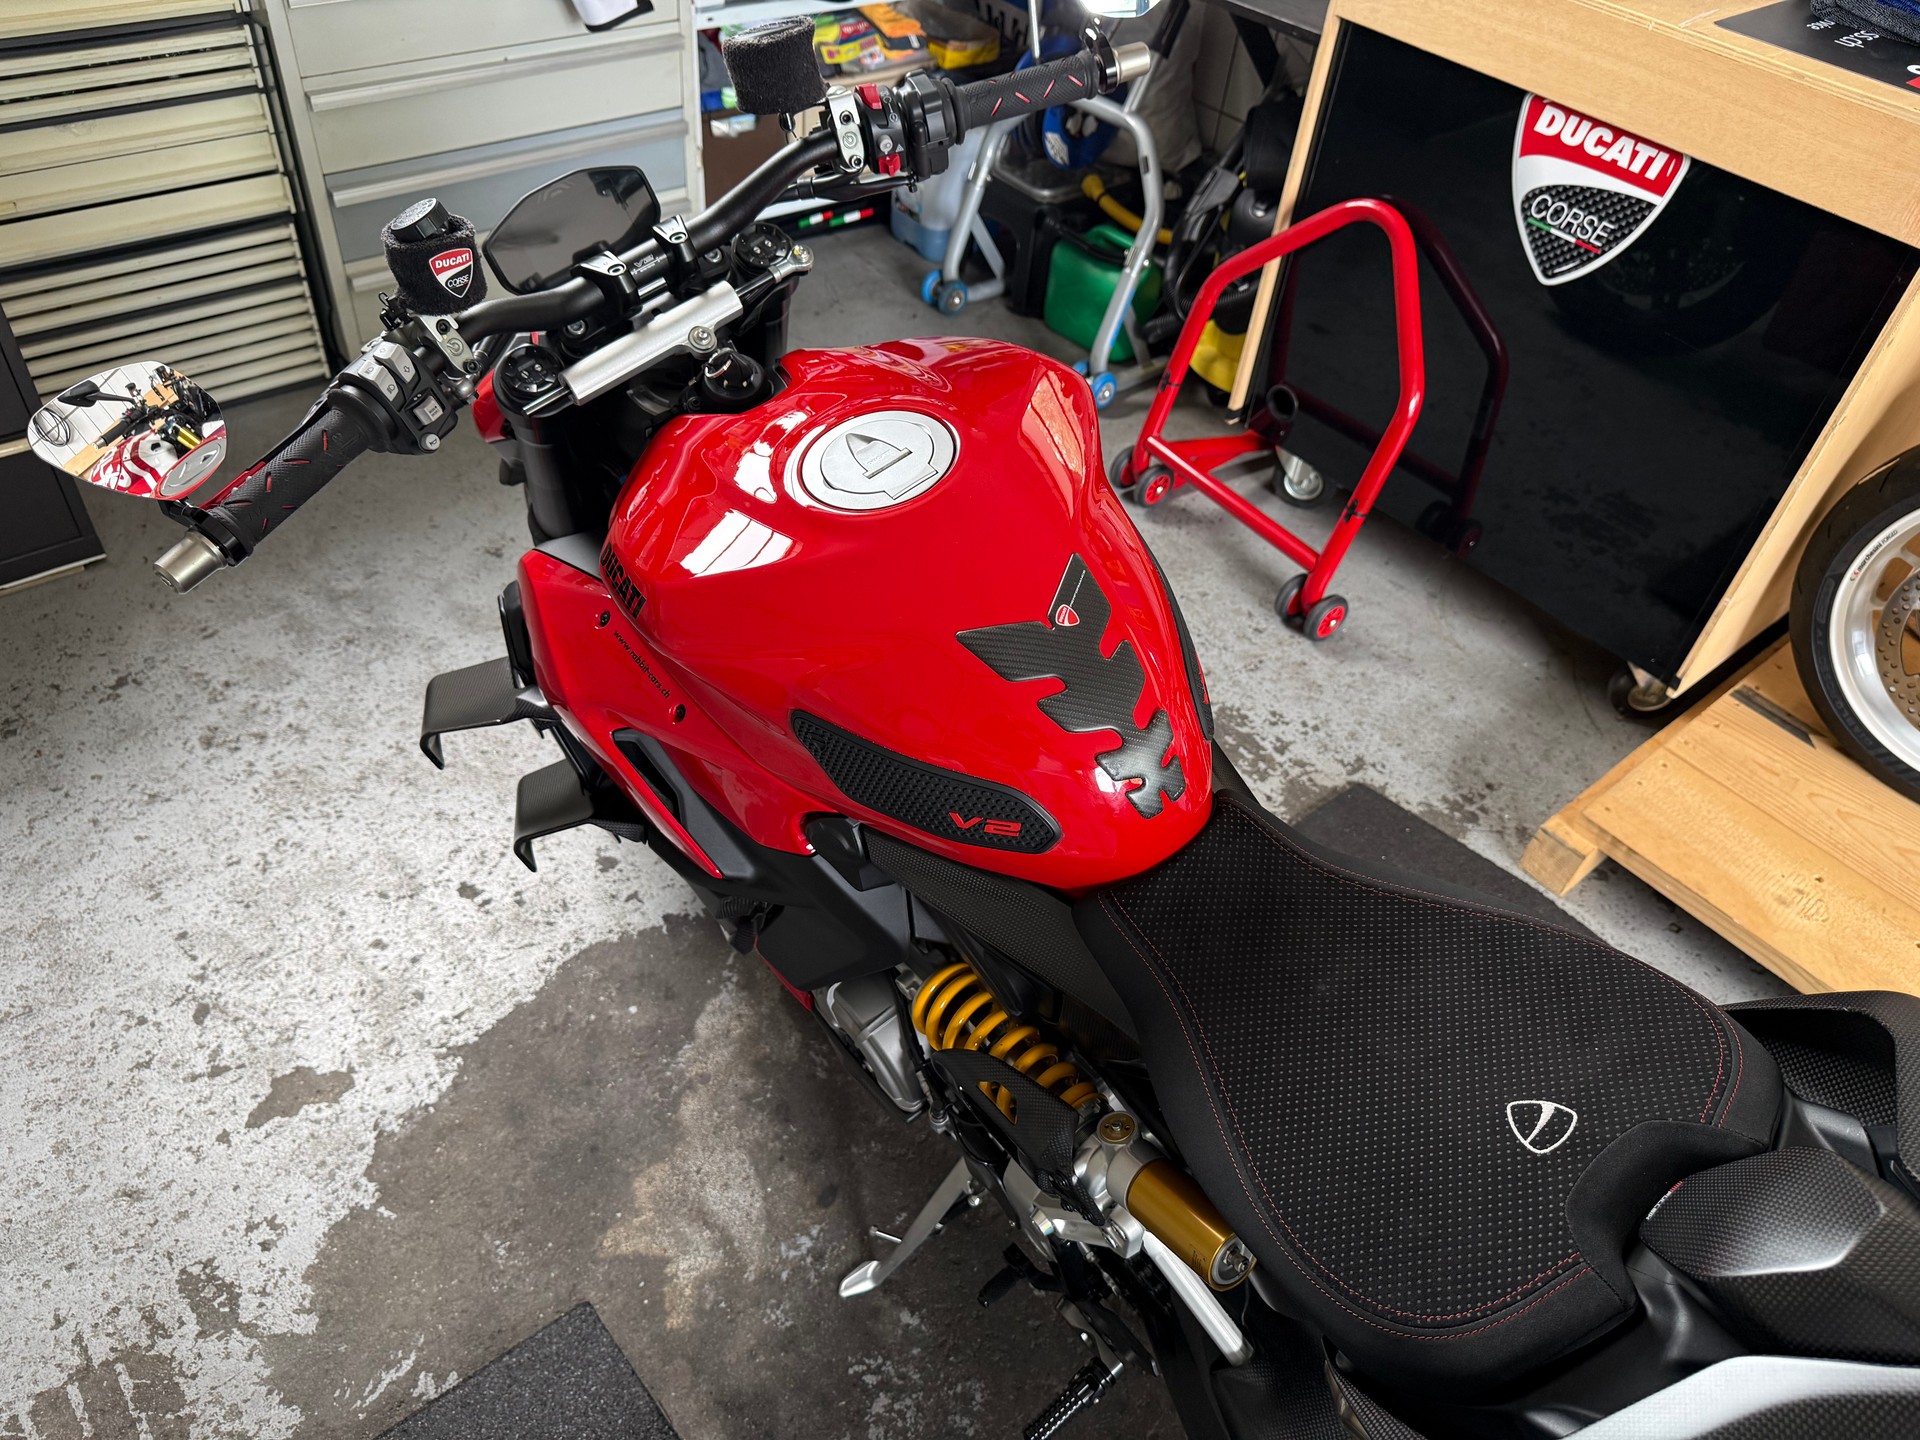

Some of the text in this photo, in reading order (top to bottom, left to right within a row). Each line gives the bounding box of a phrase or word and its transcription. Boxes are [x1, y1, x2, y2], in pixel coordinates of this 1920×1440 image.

[1834, 30, 1880, 48] ss.ch
[1533, 104, 1670, 181] DUCATI
[1530, 194, 1615, 246] CORSE
[435, 252, 470, 269] DUCATI
[447, 274, 470, 288] CORSE
[601, 542, 647, 619] DUCATI
[614, 630, 671, 698] www.rabbit-cars.ch
[949, 811, 1022, 837] V2
